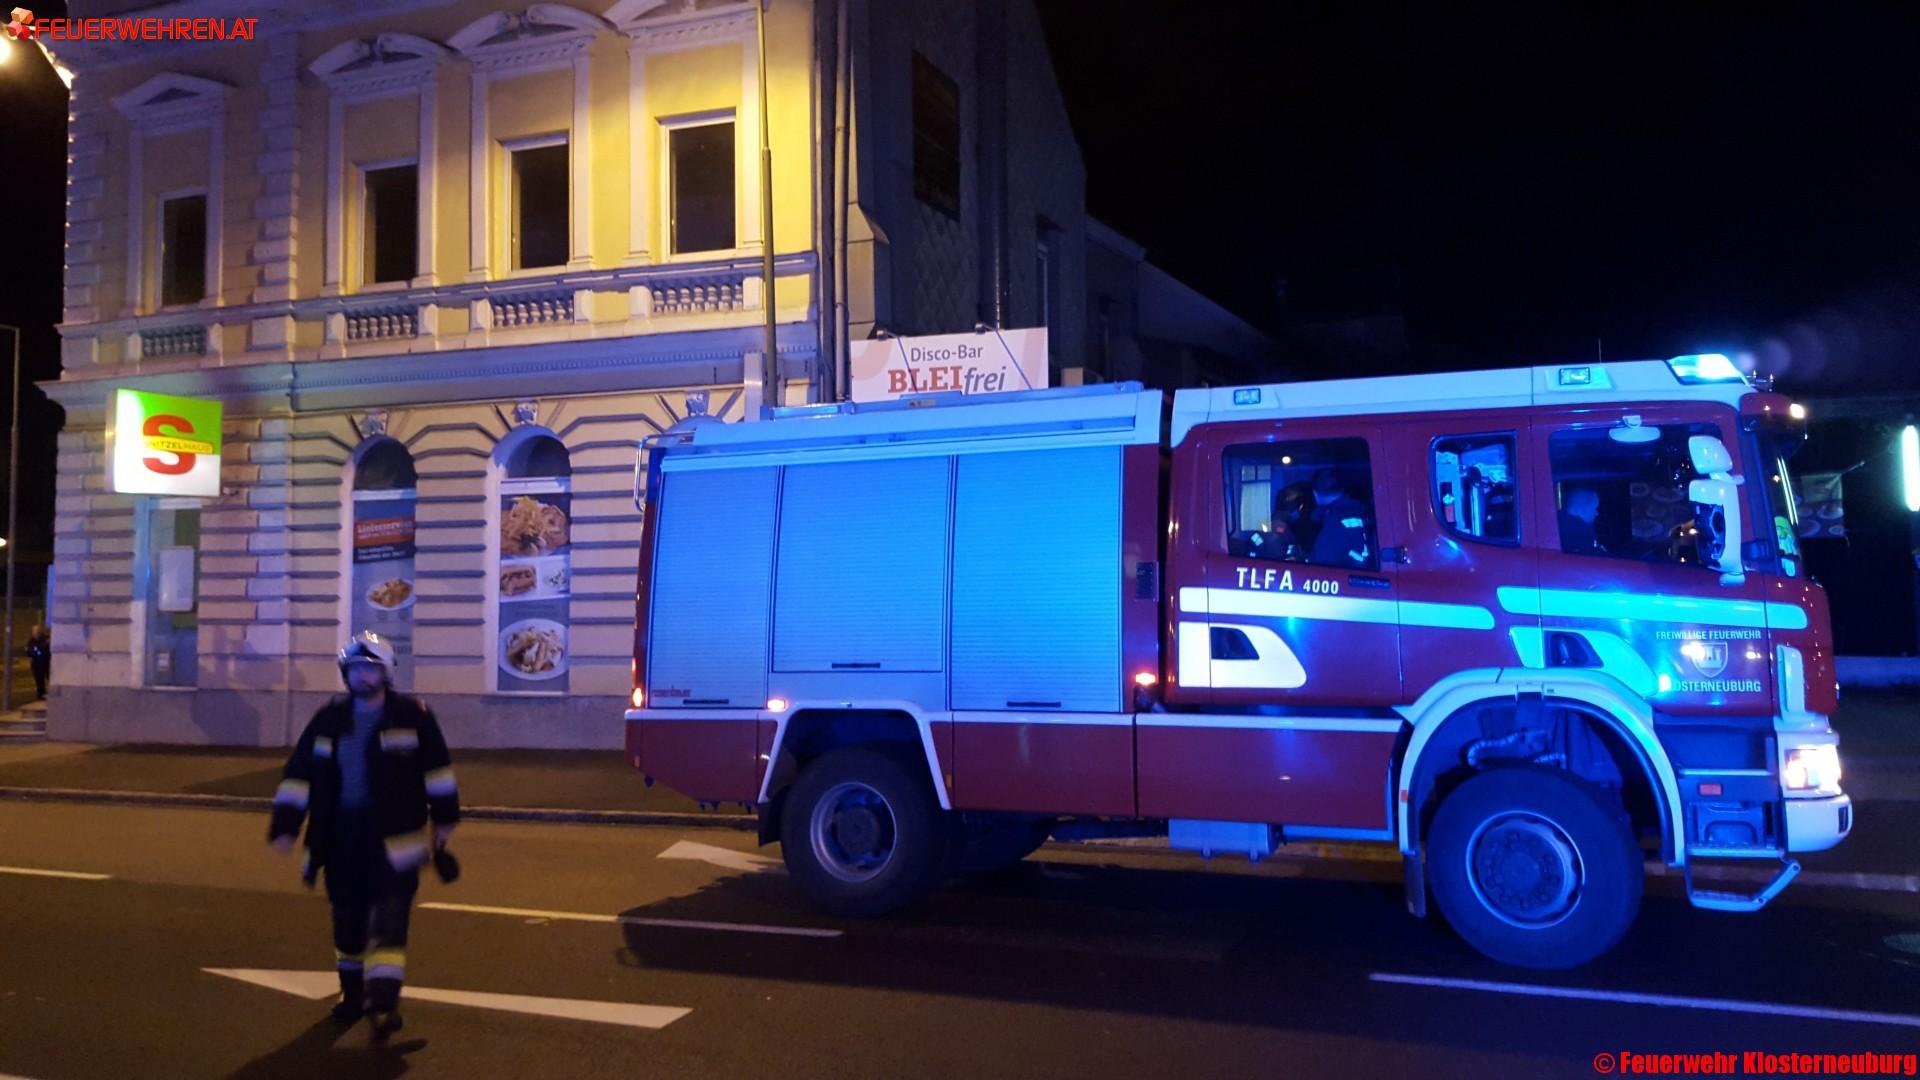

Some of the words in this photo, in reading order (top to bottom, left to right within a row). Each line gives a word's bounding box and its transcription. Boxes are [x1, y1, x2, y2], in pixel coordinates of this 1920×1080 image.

[910, 344, 984, 362] Disco-Bar
[887, 365, 1007, 395] BLEIfrei
[1236, 567, 1294, 591] TLFA
[1302, 579, 1339, 594] 4000
[1656, 630, 1707, 640] FREIWILLIGE
[1709, 630, 1761, 640] FEUERWEHR
[1663, 679, 1761, 692] OSTERNEUBURG
